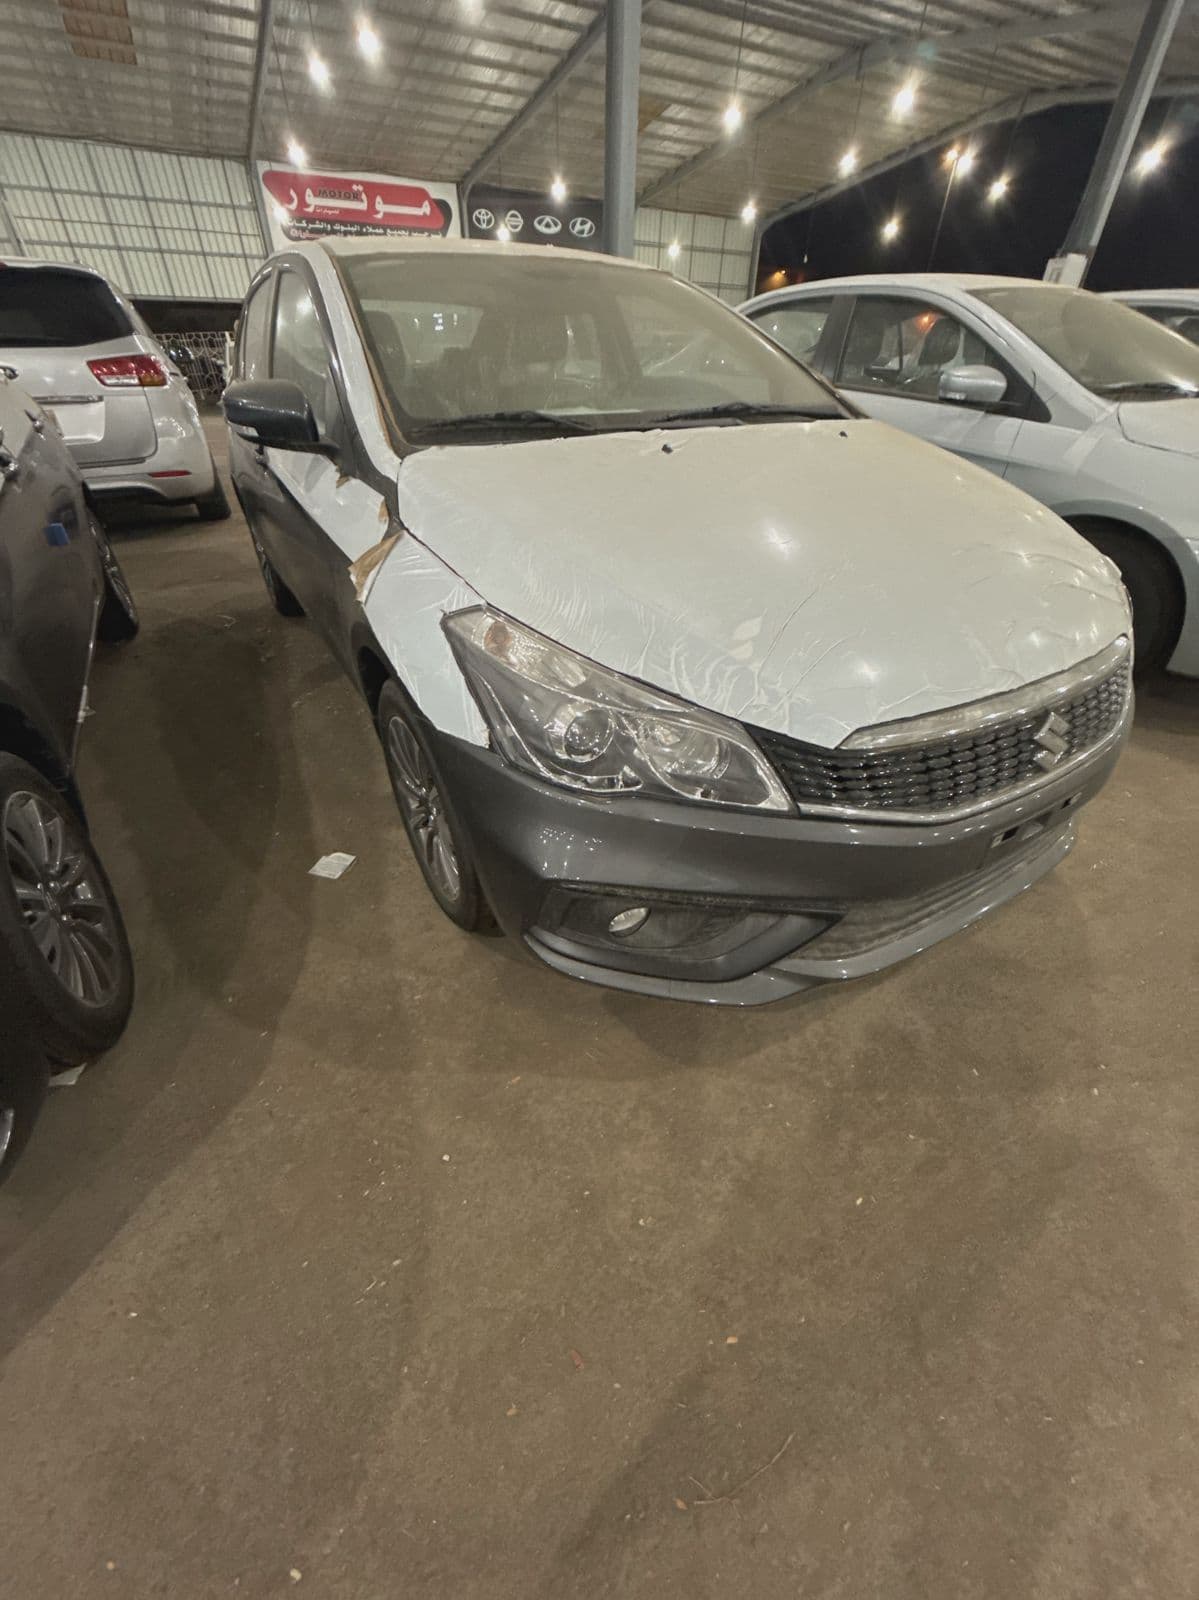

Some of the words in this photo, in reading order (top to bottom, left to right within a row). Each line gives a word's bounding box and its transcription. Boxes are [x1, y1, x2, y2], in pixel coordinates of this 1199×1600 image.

[284, 184, 431, 218] موتور
[317, 189, 359, 201] MOTOR
[287, 218, 331, 231] والشركات
[332, 222, 360, 233] البنوك
